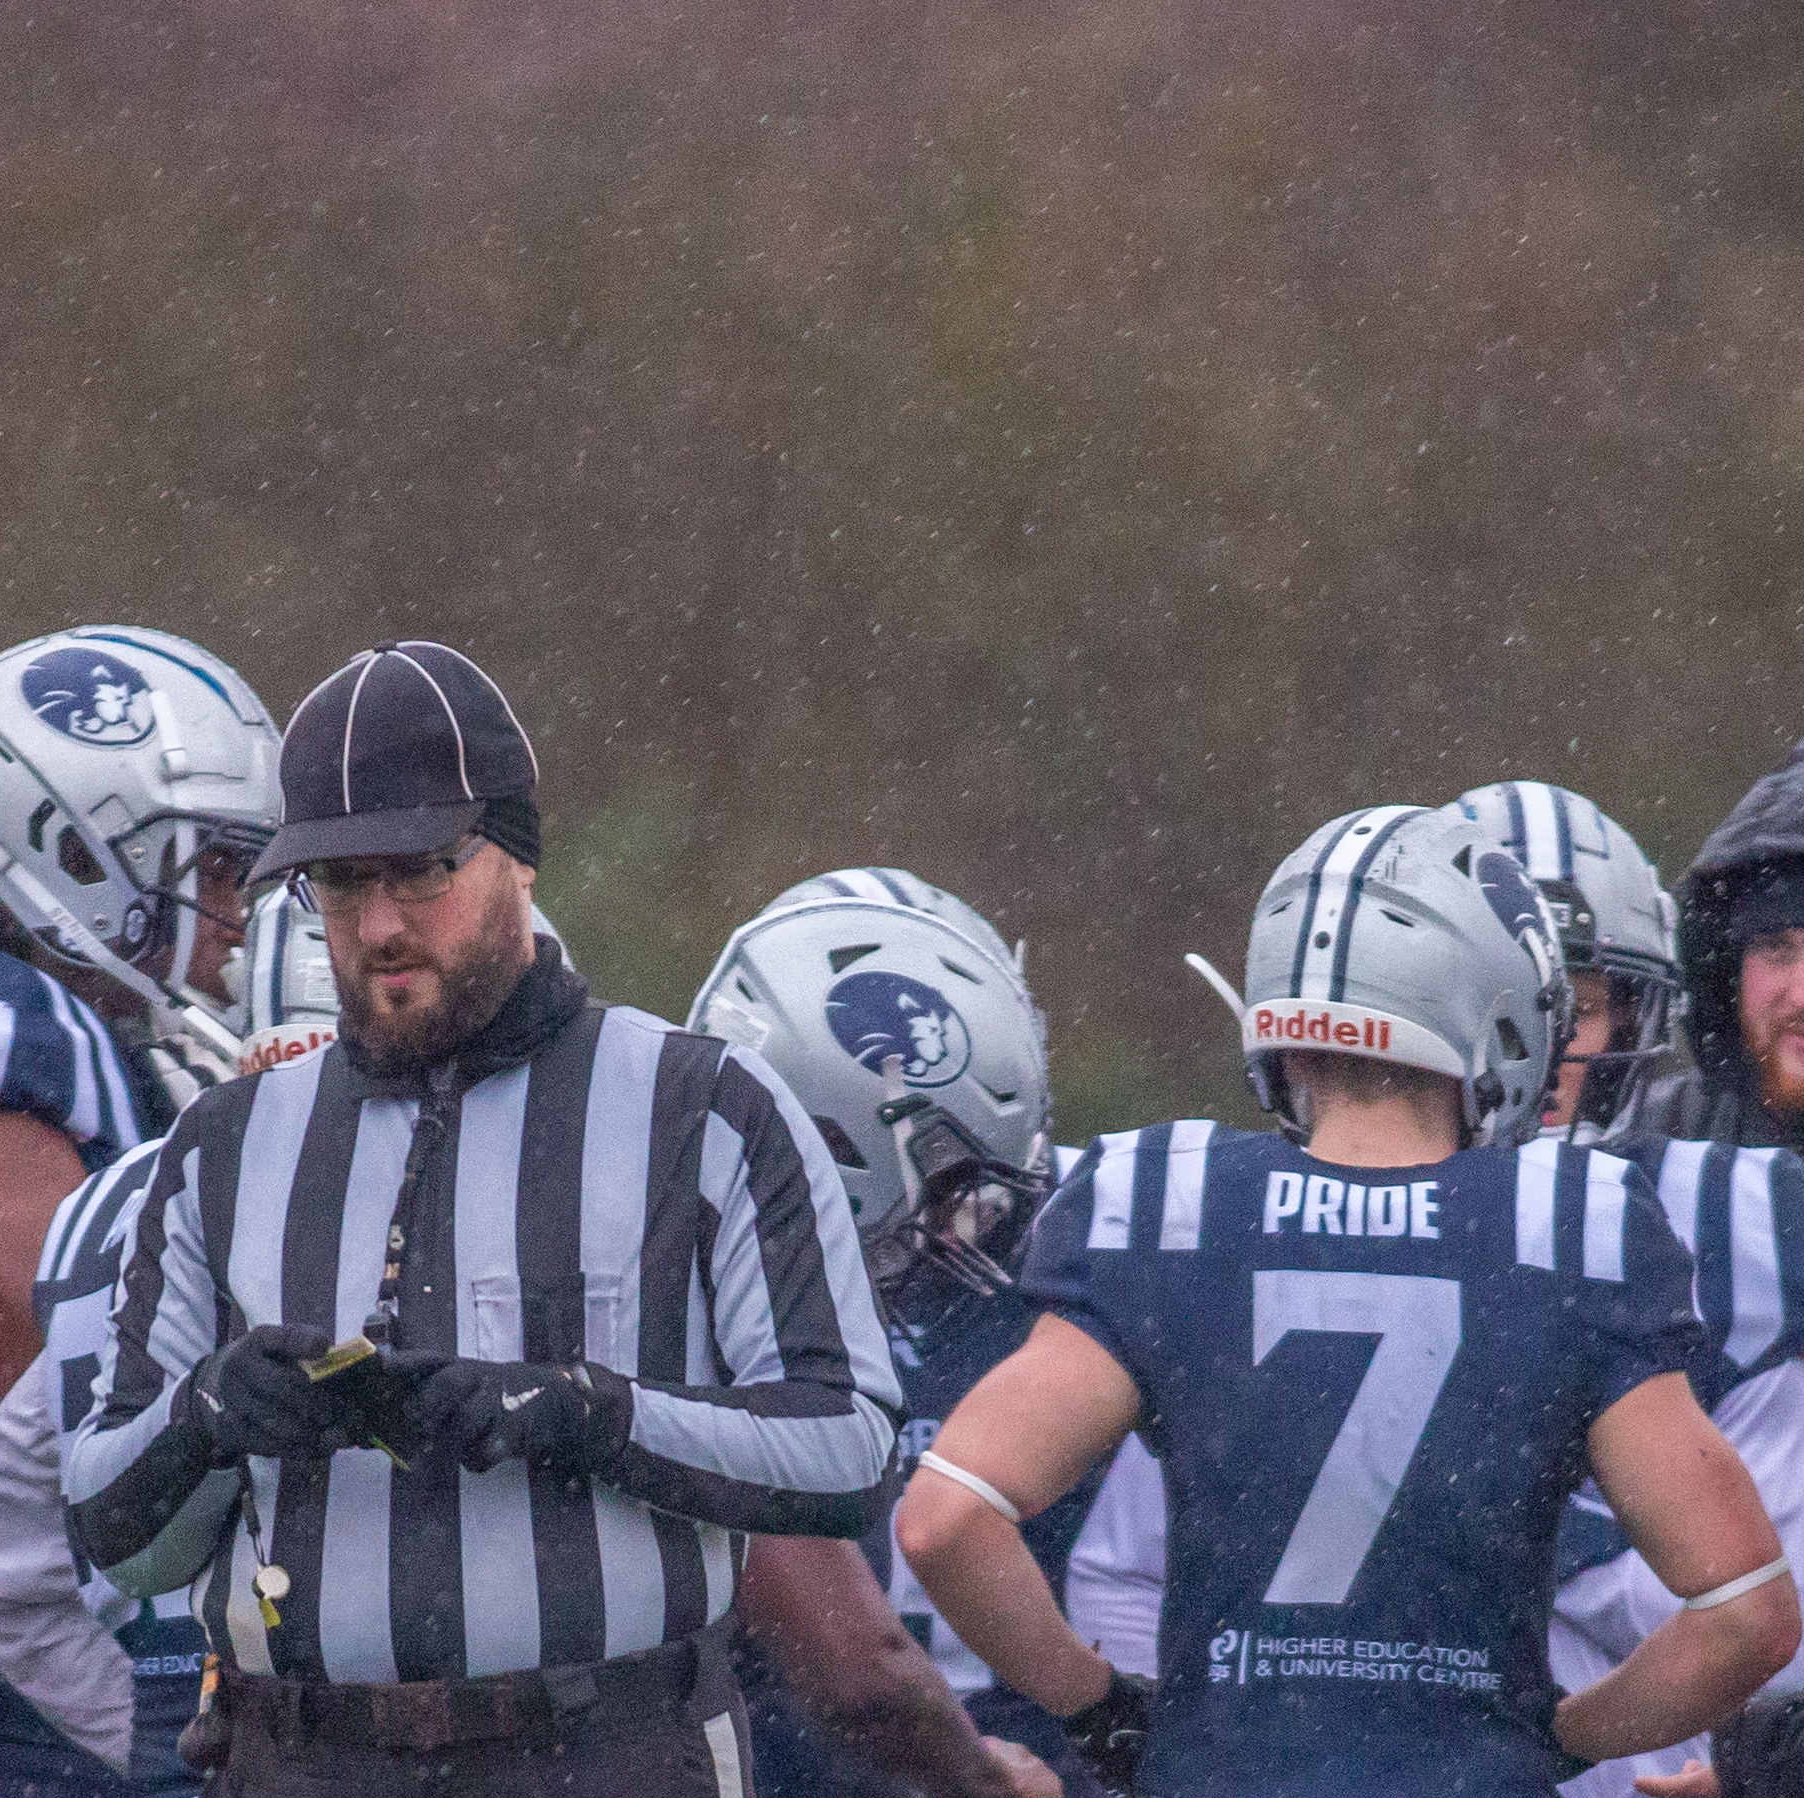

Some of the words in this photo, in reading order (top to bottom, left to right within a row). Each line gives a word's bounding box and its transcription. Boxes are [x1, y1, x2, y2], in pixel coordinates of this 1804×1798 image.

[1255, 1009, 1390, 1050] Riddell
[1263, 1170, 1441, 1239] PRIDE
[1252, 1270, 1462, 1603] 7
[1256, 1637, 1347, 1656] HIGHER
[1353, 1640, 1490, 1668] EDUCATION
[1255, 1659, 1273, 1677] &
[1280, 1659, 1411, 1681] UNIVERSITY
[1416, 1664, 1504, 1690] CENTRE
